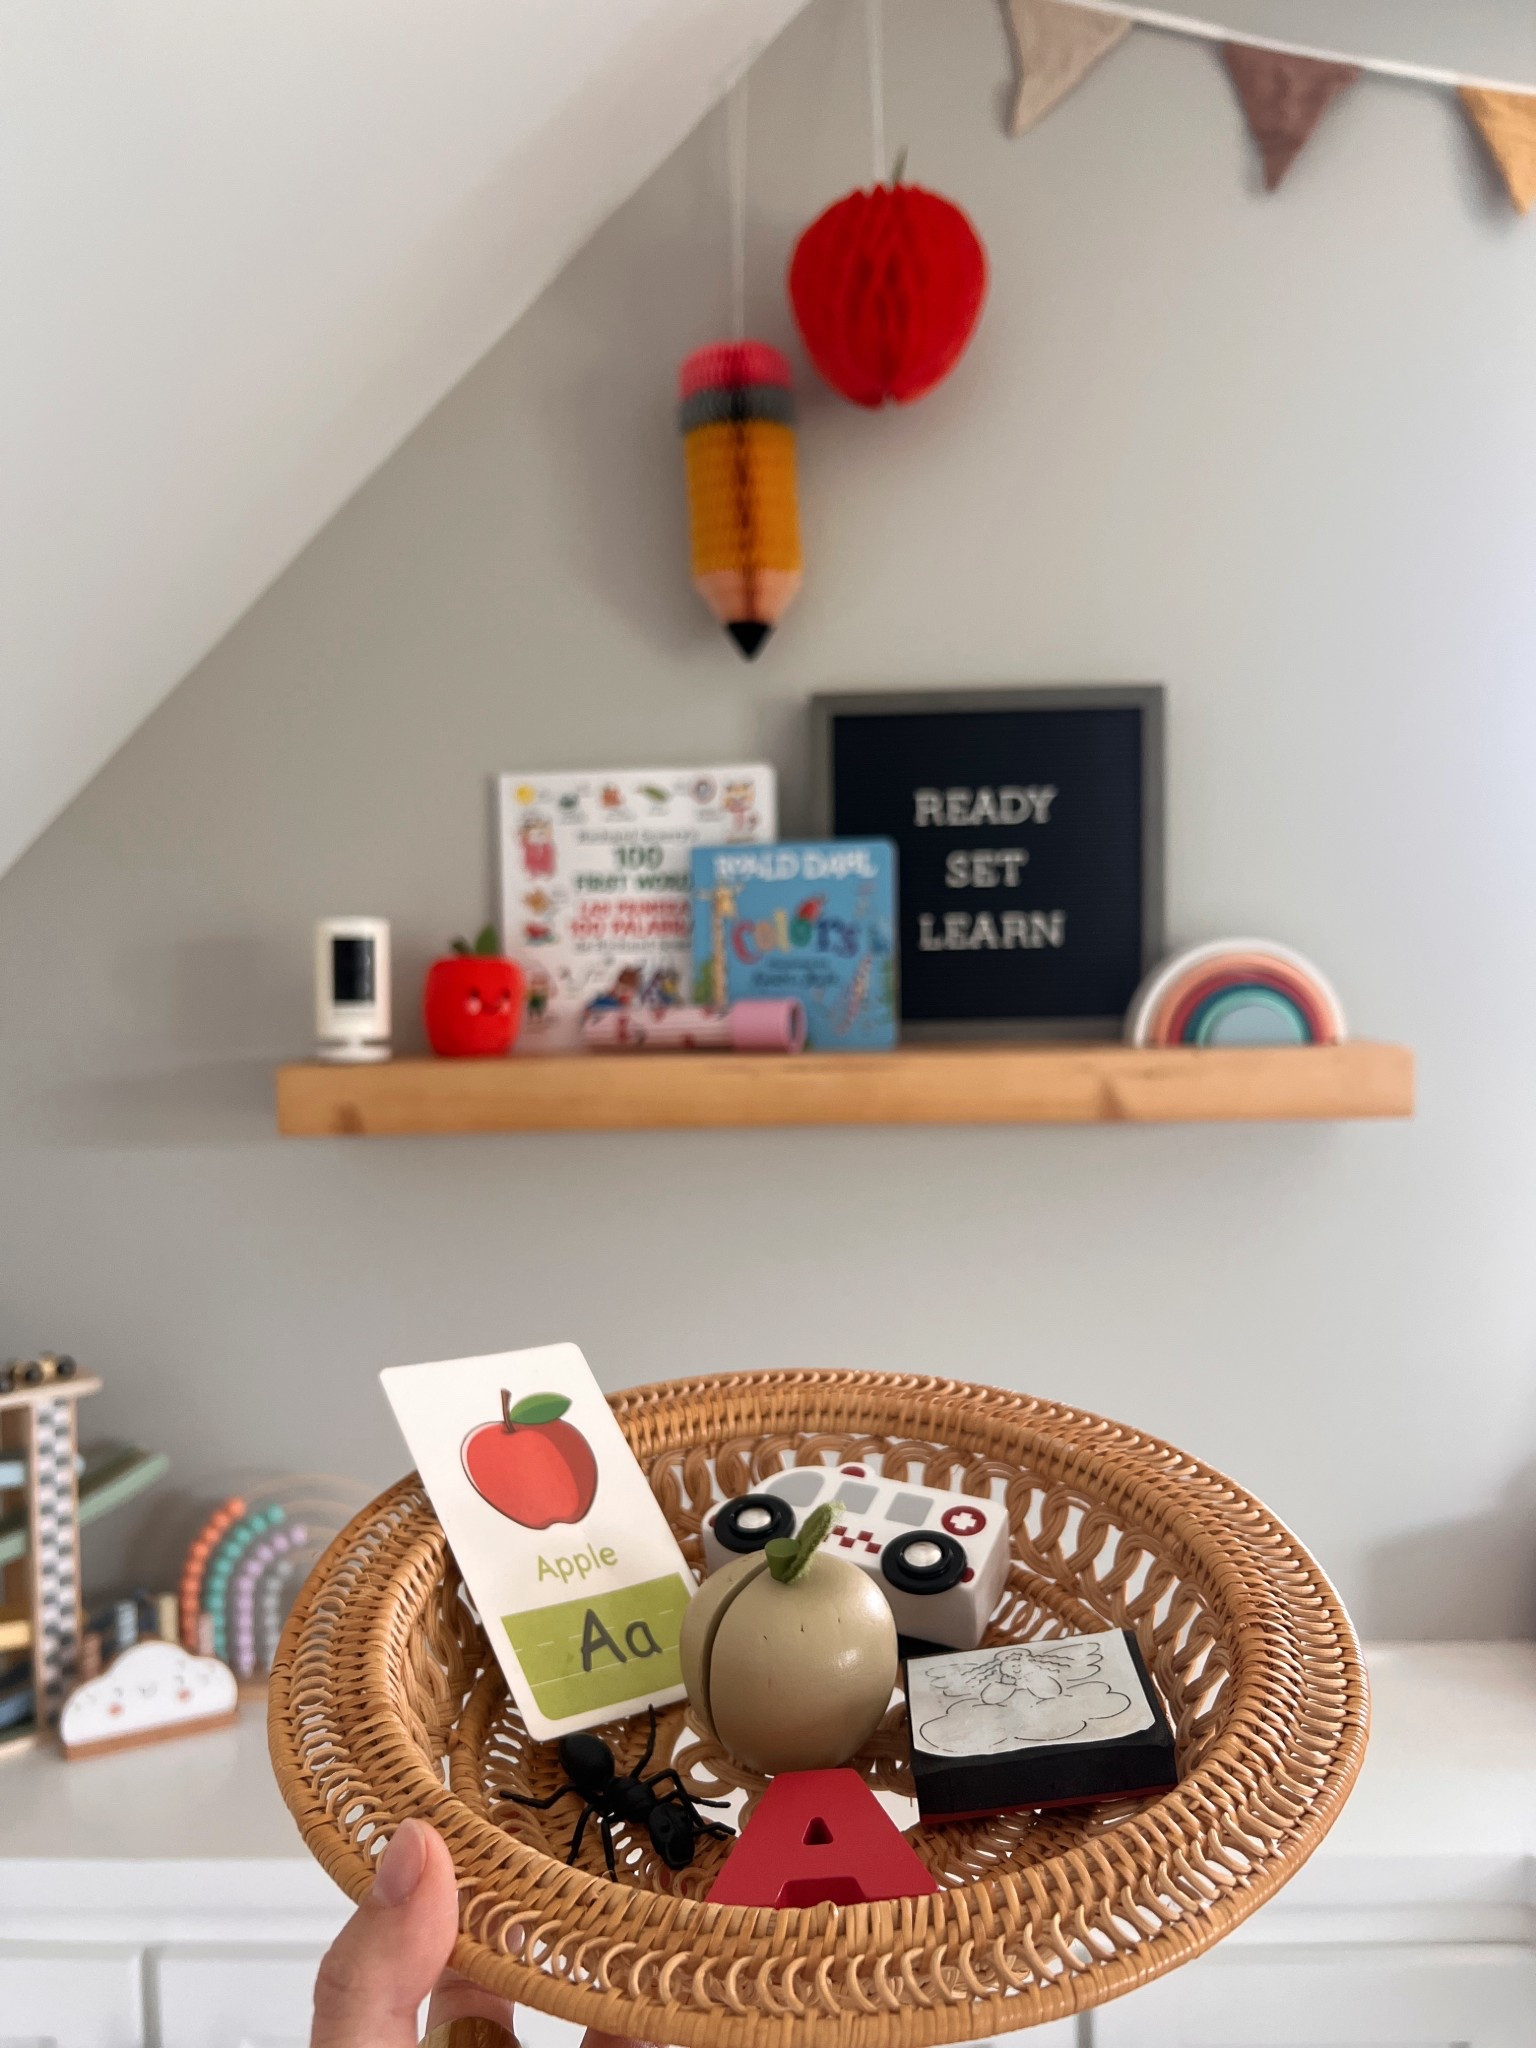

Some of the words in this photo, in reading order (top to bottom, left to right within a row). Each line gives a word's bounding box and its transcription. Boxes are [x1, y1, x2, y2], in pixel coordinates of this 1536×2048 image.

[913, 785, 1057, 827] READY
[614, 845, 663, 869] 100
[945, 848, 1029, 888] SET
[918, 910, 1066, 951] LEARN
[536, 1543, 618, 1584] Apple
[580, 1608, 663, 1672] Aa
[704, 1768, 940, 1909] A
